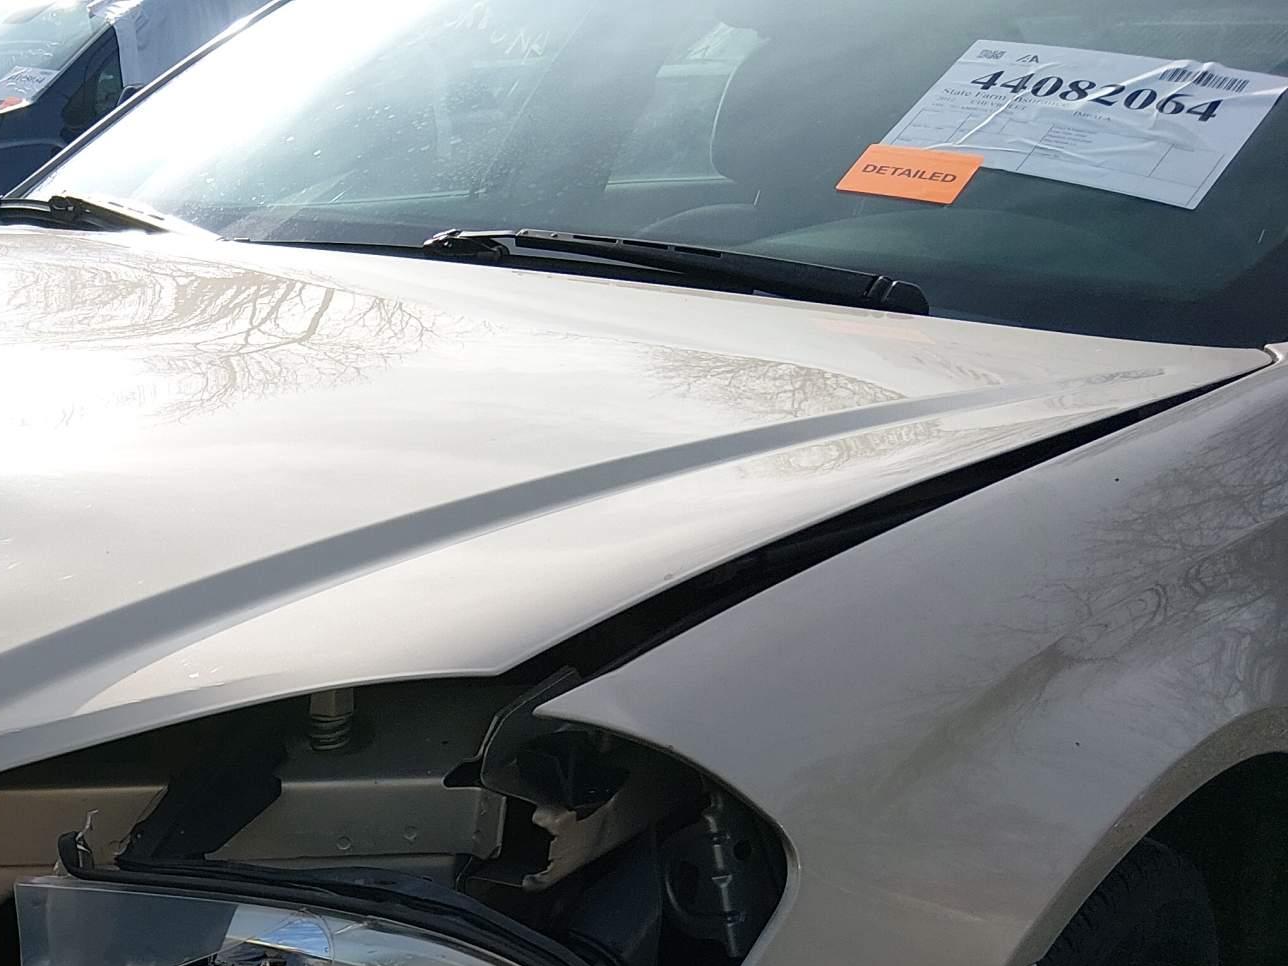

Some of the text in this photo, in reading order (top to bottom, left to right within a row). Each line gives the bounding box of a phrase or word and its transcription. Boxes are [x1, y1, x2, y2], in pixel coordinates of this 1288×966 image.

[942, 87, 970, 98] State
[974, 90, 1007, 102] Farm
[970, 69, 1223, 122] 44082064
[861, 163, 957, 184] DETAILED
